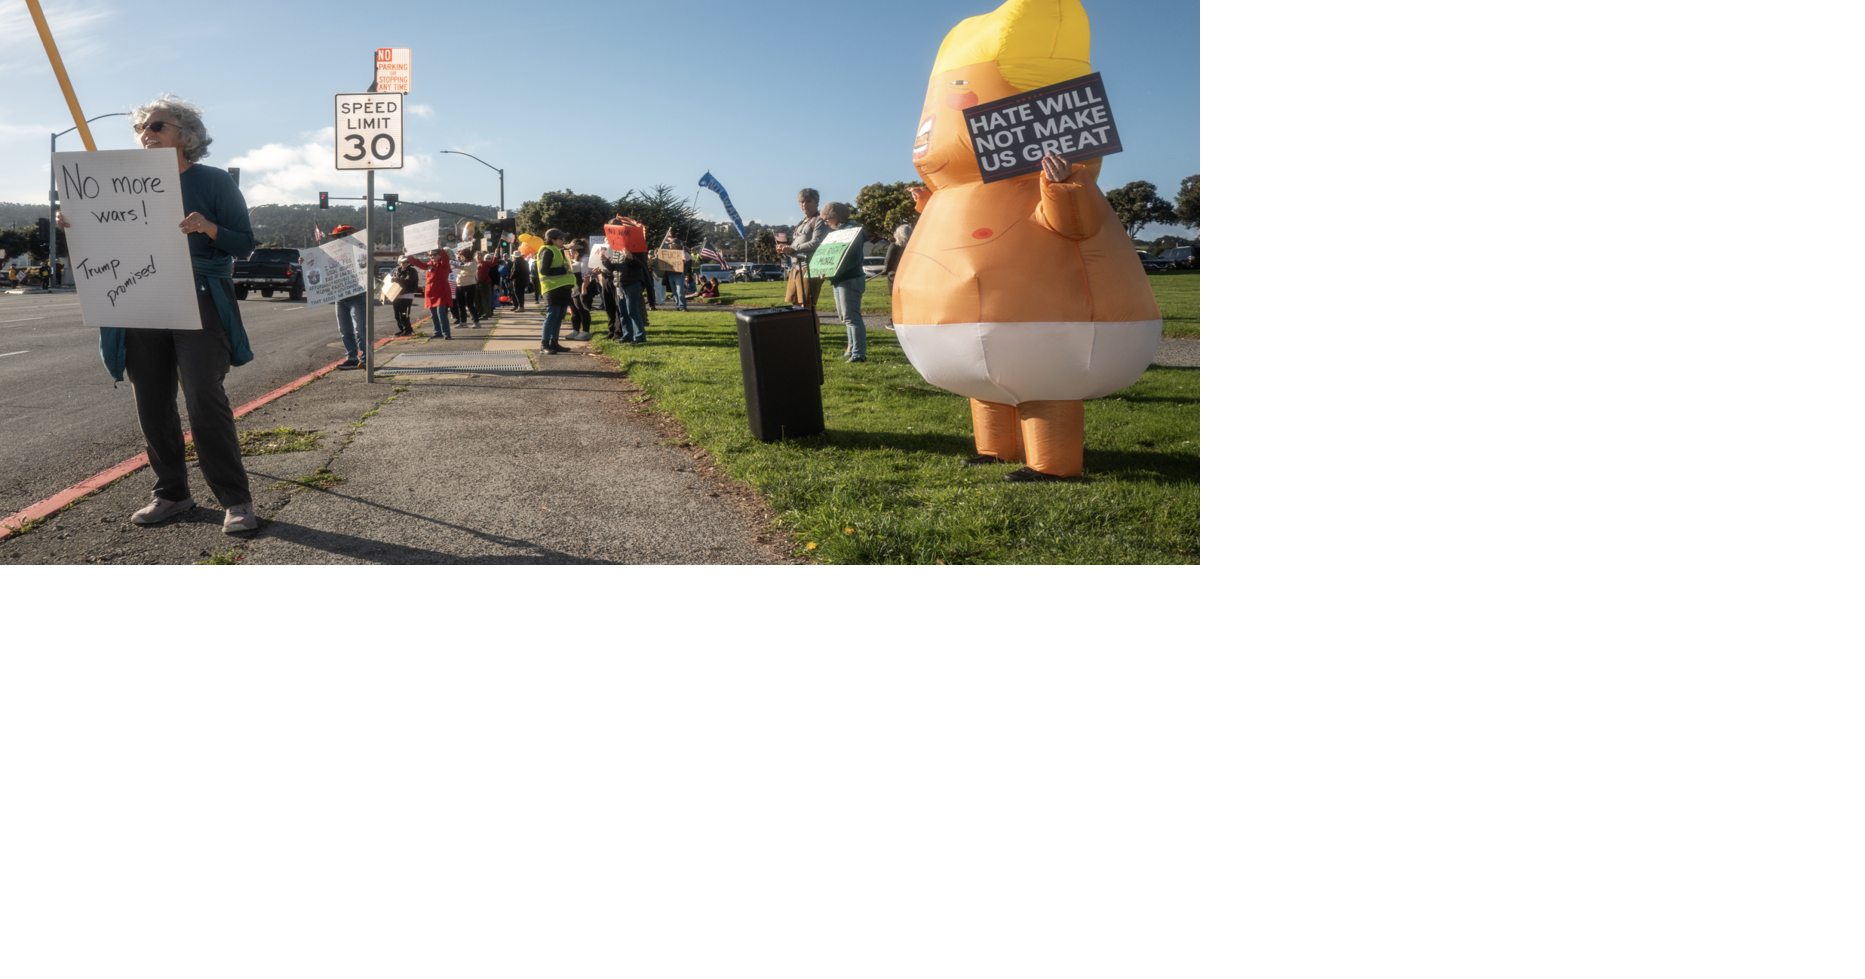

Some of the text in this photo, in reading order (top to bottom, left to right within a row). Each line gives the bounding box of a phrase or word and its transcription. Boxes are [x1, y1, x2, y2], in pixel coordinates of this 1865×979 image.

[378, 49, 391, 61] NO
[378, 63, 408, 71] PARKING
[378, 76, 408, 84] STOPPING
[378, 83, 408, 91] ANY TIME
[341, 102, 397, 114] SPEED
[969, 86, 1102, 134] HATE WILL
[347, 117, 391, 130] LIMIT
[975, 105, 1108, 153] NOT MAKE
[343, 133, 395, 161] 30
[980, 125, 1111, 172] US GREAT
[62, 163, 165, 200] No more
[91, 200, 148, 225] wars!
[661, 250, 682, 260] FUCK
[76, 257, 121, 280] Trump
[106, 254, 157, 307] promised
[352, 285, 367, 294] PEOPL
